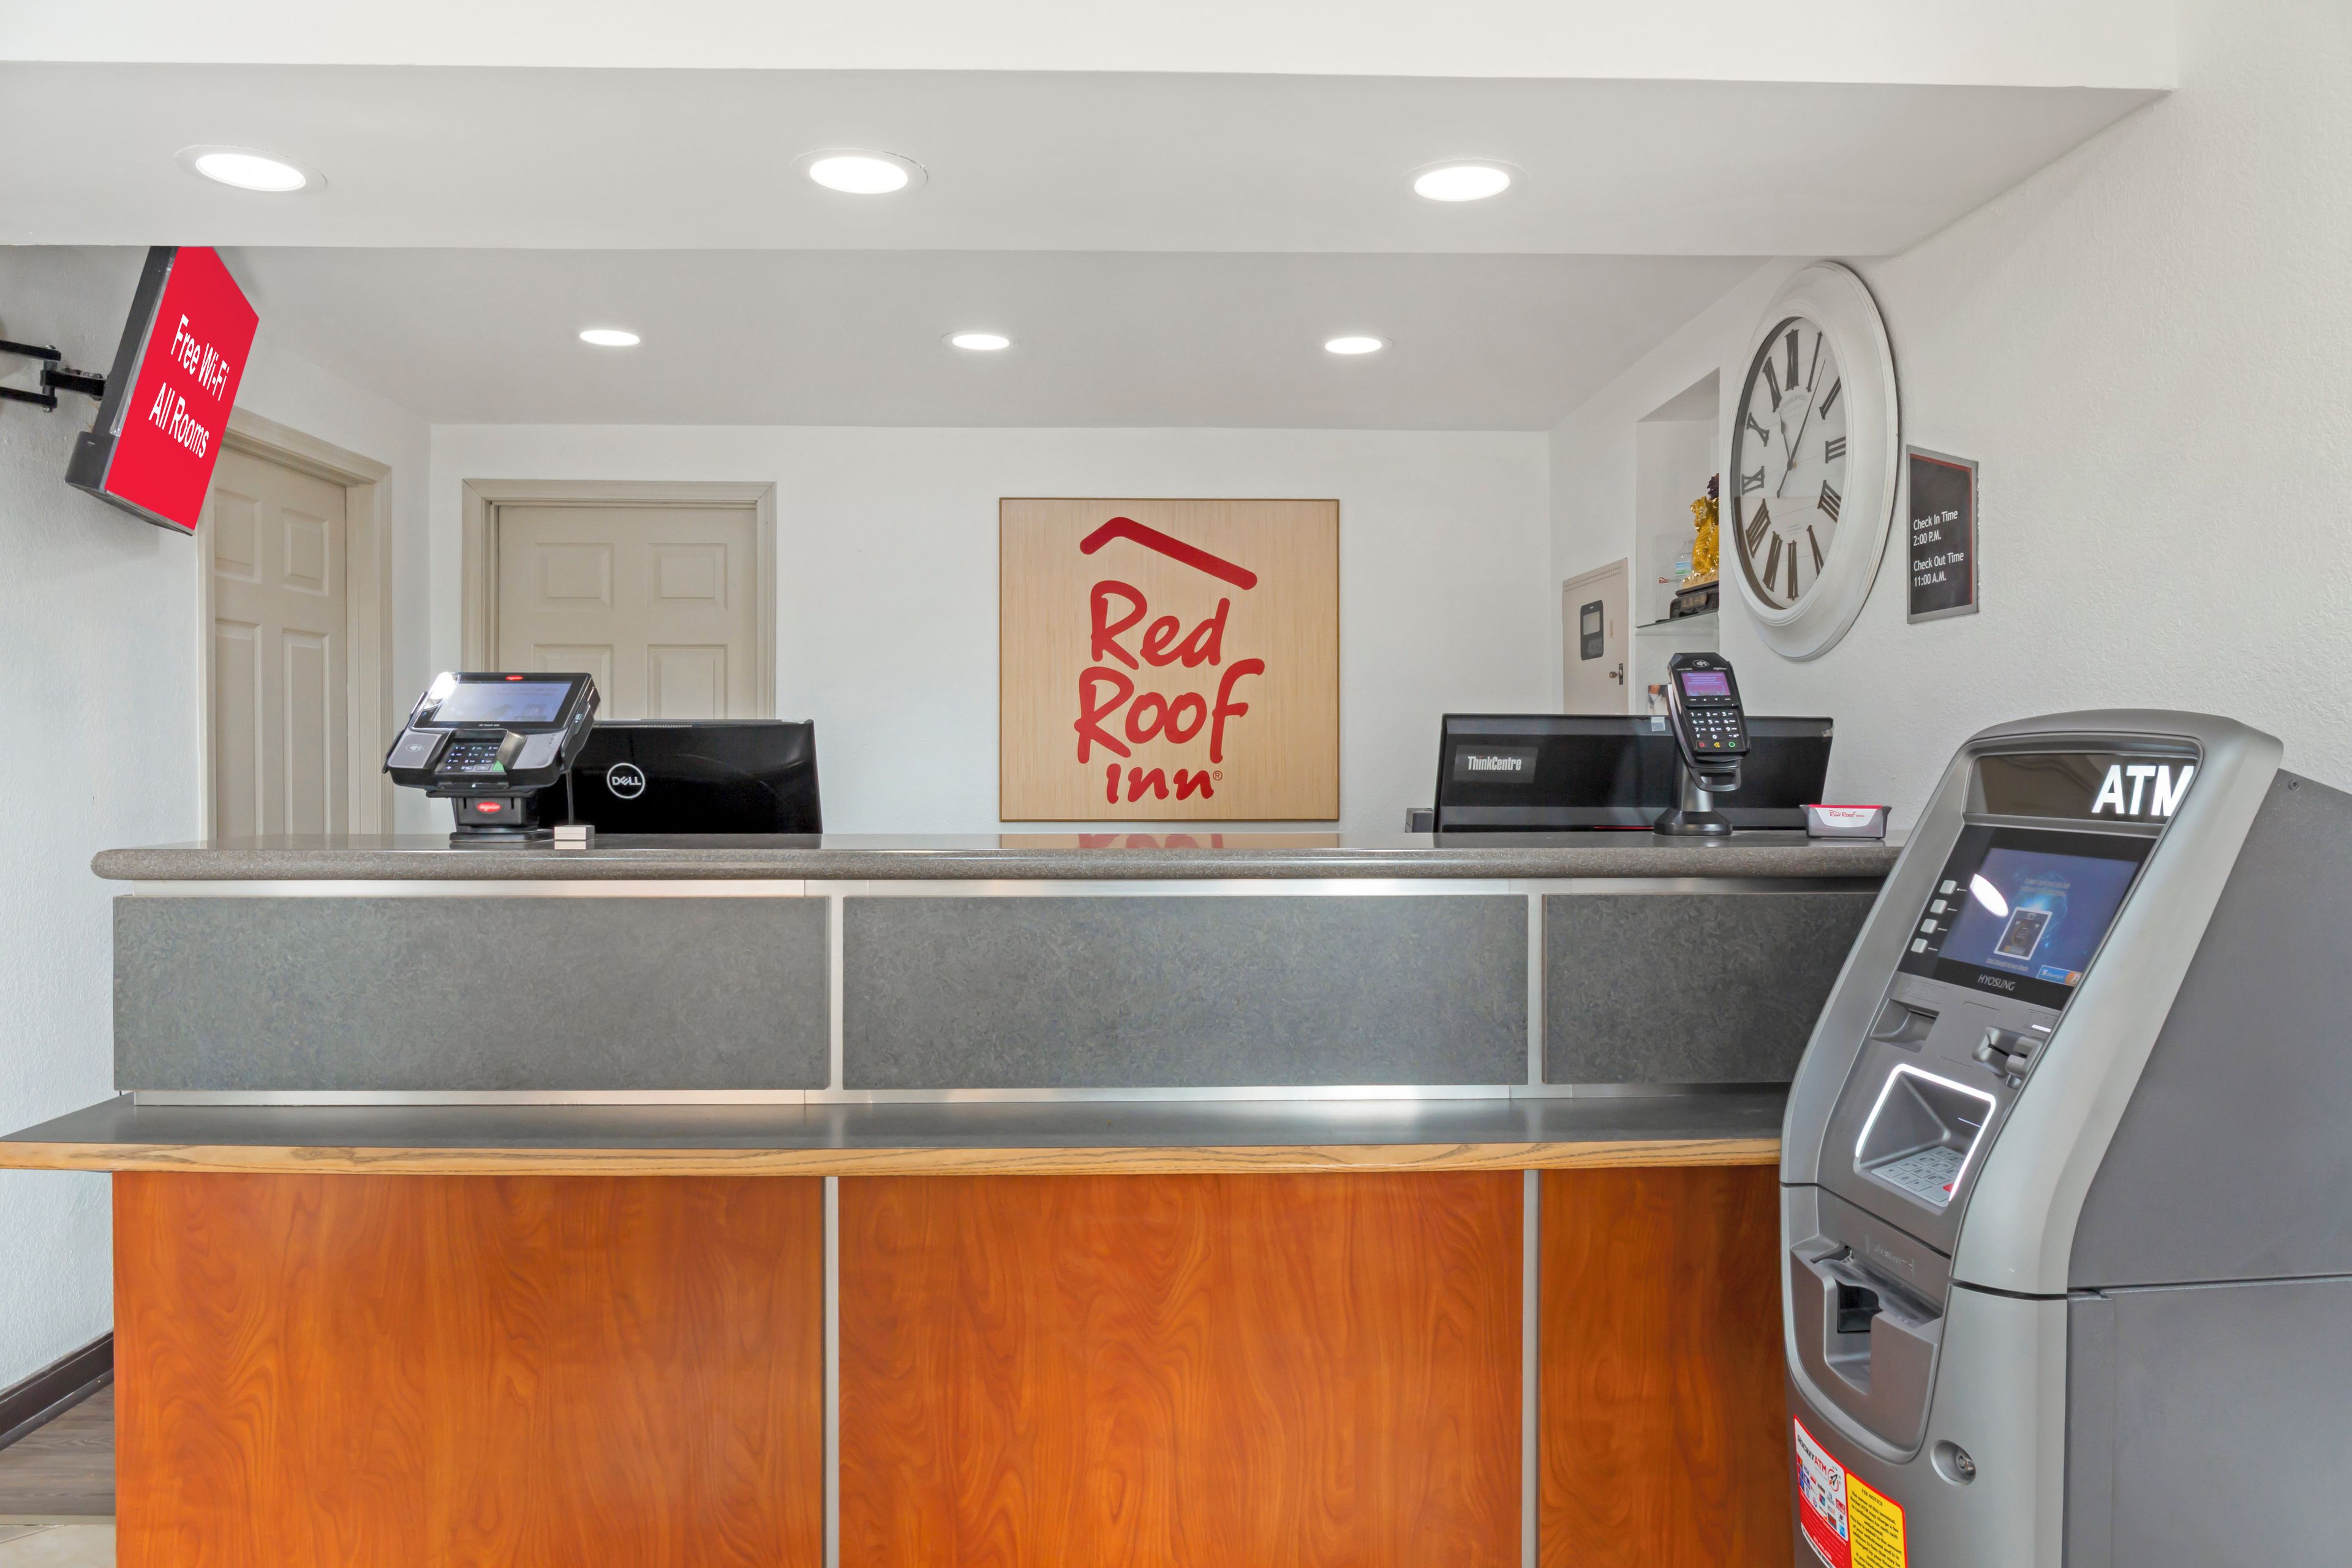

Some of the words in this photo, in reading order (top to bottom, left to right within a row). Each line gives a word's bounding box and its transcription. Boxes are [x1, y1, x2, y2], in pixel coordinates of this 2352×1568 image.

[170, 314, 201, 375] Free
[198, 342, 230, 402] Wi-Fi
[148, 382, 176, 430] All
[168, 396, 209, 458] Rooms
[1746, 412, 1770, 447] X
[1825, 435, 1846, 464] III
[1913, 515, 1932, 530] Check
[1934, 514, 1940, 525] In
[1941, 510, 1958, 522] Time
[1913, 532, 1928, 546] 2:00
[1929, 529, 1942, 543] P.M.
[1913, 557, 1933, 571] Check
[1934, 555, 1946, 567] Out
[1947, 552, 1964, 564] Time
[1914, 573, 1931, 587] 11:00
[1932, 570, 1947, 584] A.M.
[1090, 579, 1231, 670] Red
[1073, 658, 1265, 764] Roof
[1468, 755, 1521, 771] ThinkCentre
[612, 776, 641, 786] DELL
[2091, 765, 2194, 816] ATM
[1977, 974, 2016, 990] HYOSUNG
